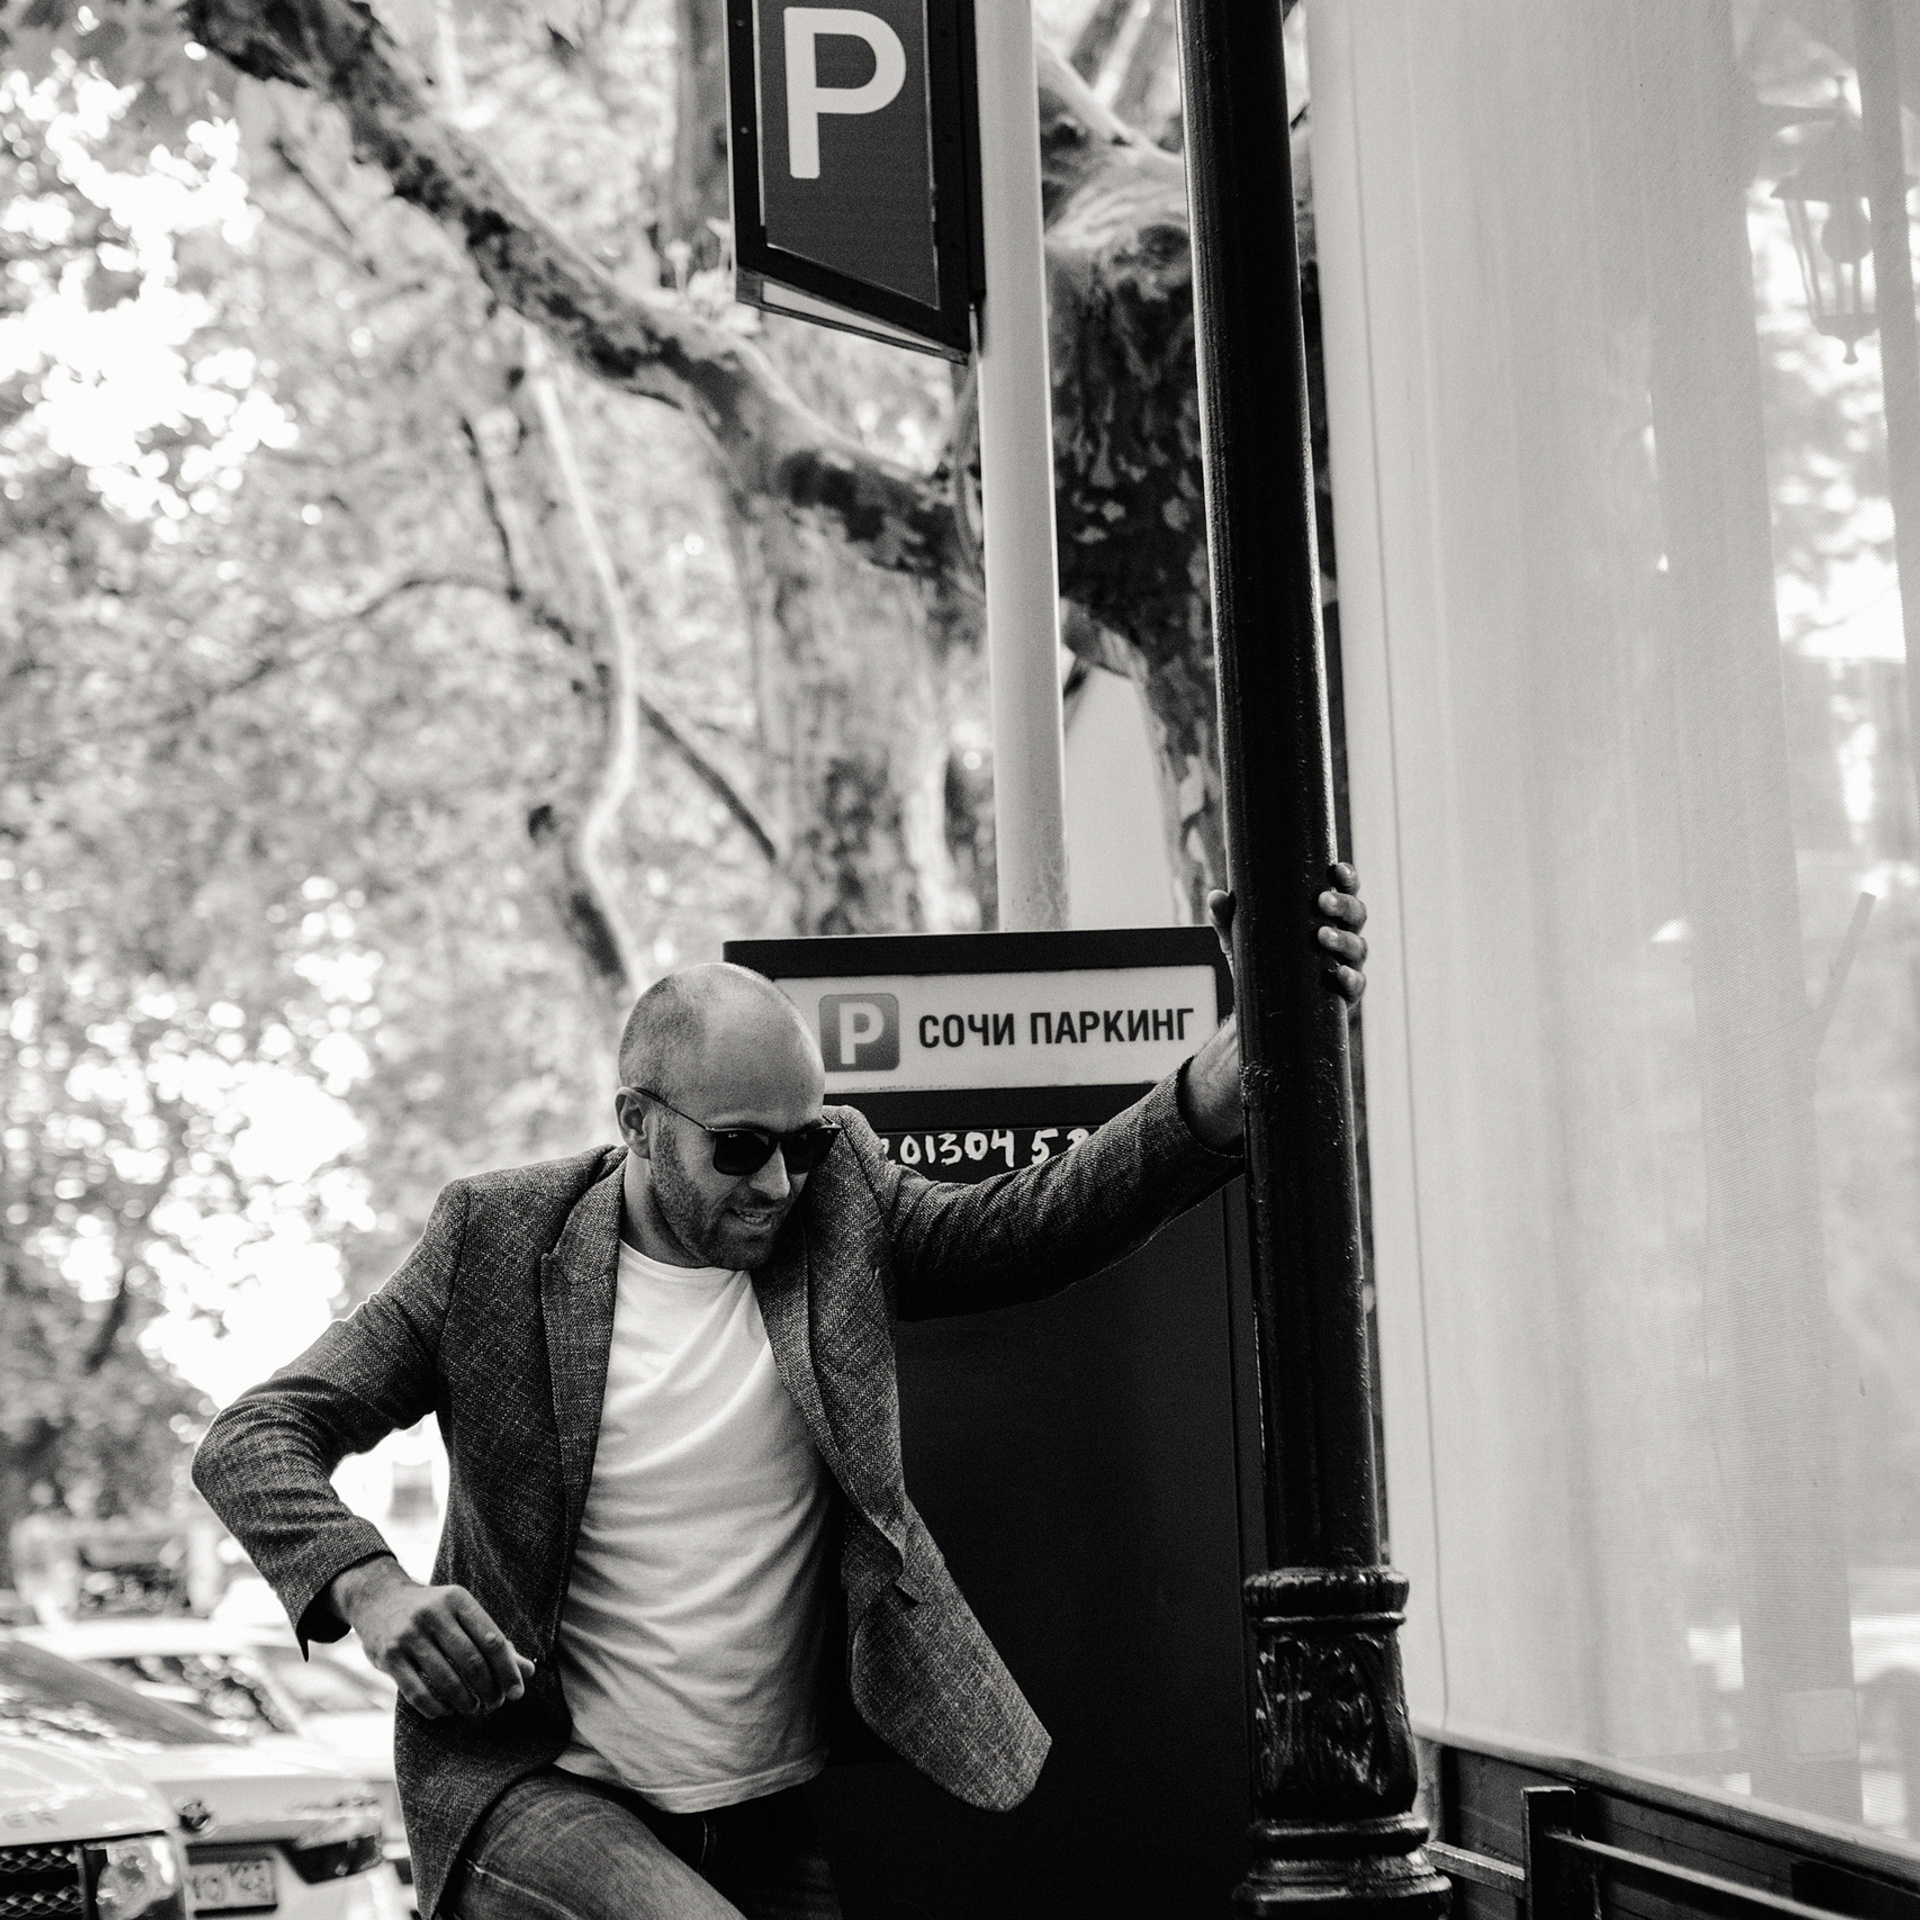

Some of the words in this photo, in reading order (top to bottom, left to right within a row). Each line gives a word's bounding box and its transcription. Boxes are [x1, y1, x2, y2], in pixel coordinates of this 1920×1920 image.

[783, 6, 907, 180] P
[839, 1002, 884, 1065] P
[918, 1013, 1015, 1049] СОЧИ
[1030, 1007, 1194, 1045] ПАРКИНГ
